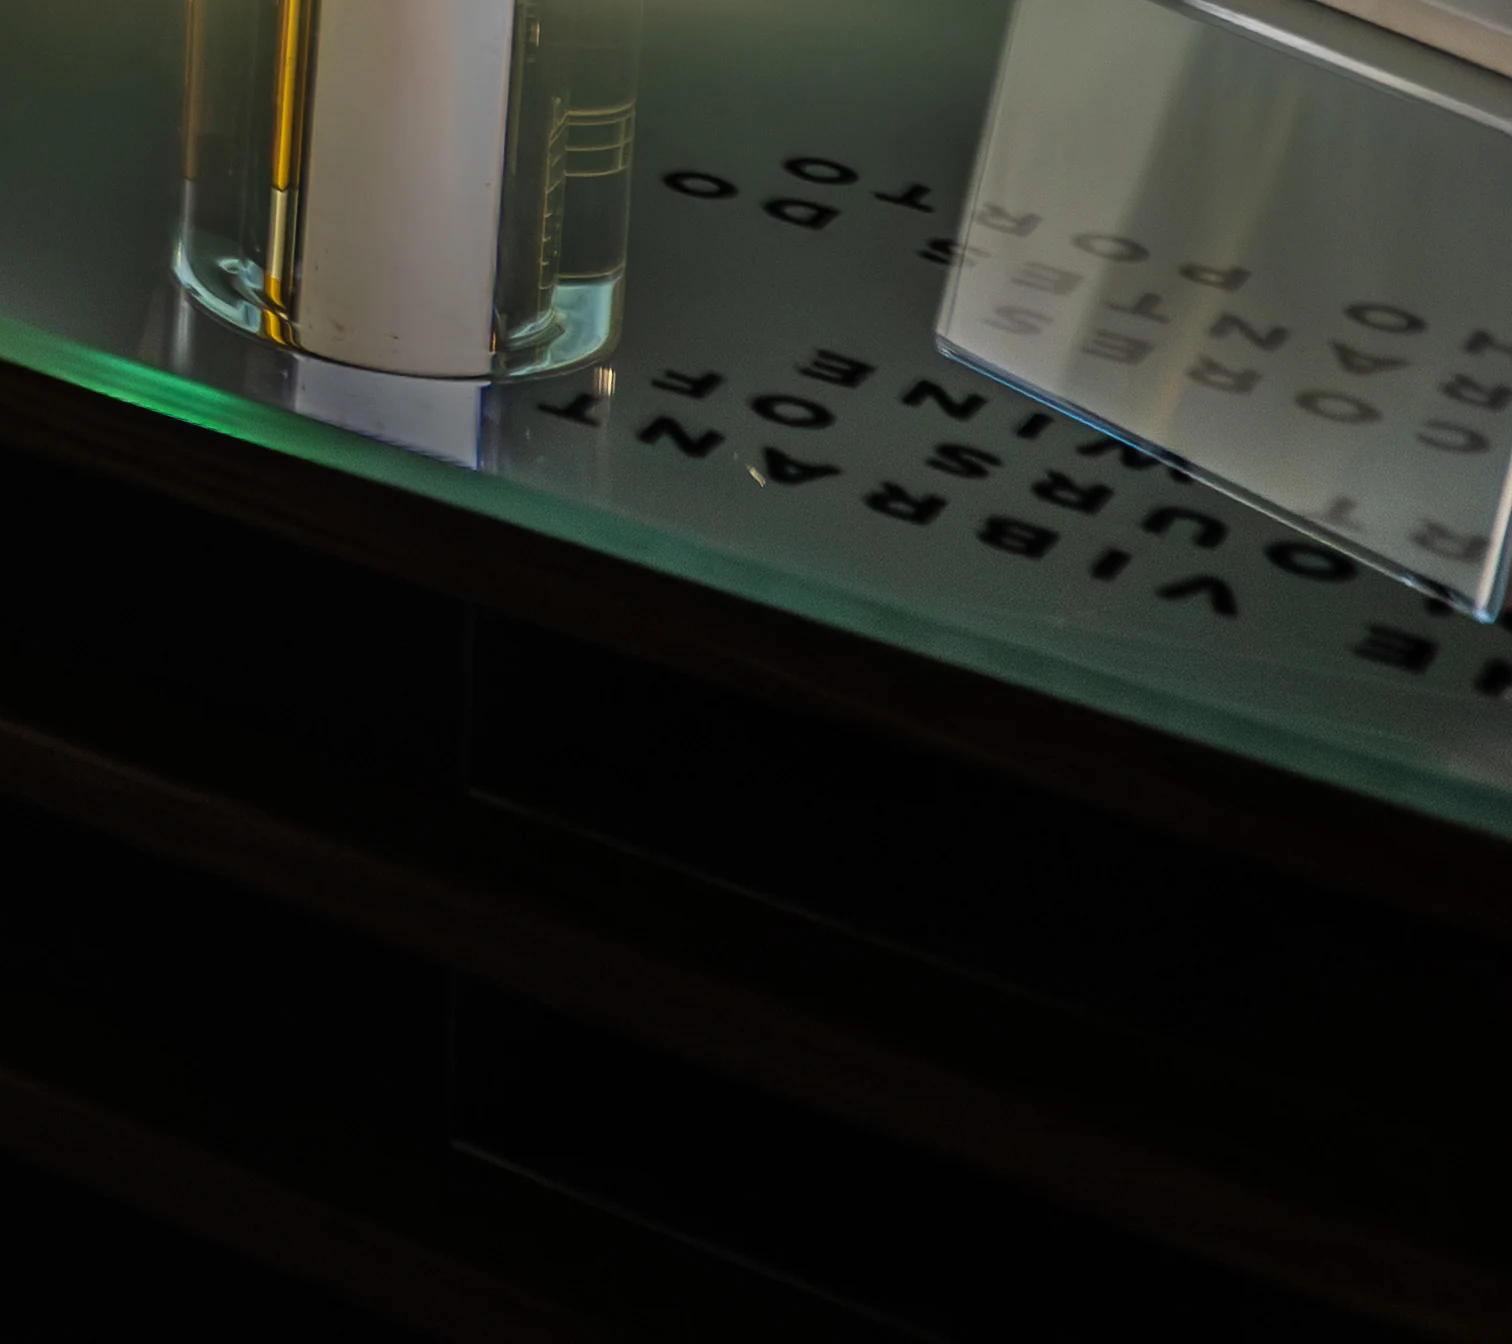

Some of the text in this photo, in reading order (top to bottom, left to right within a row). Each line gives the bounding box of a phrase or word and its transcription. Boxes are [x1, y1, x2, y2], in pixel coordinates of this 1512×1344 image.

[663, 170, 841, 229] DO
[783, 156, 1252, 291] PORTO
[918, 235, 1511, 413] RANTES
[981, 304, 1492, 455] CORES
[650, 367, 1454, 616] OURS OF
[797, 348, 1195, 484] WINE
[537, 390, 1239, 617] VIBRANT
